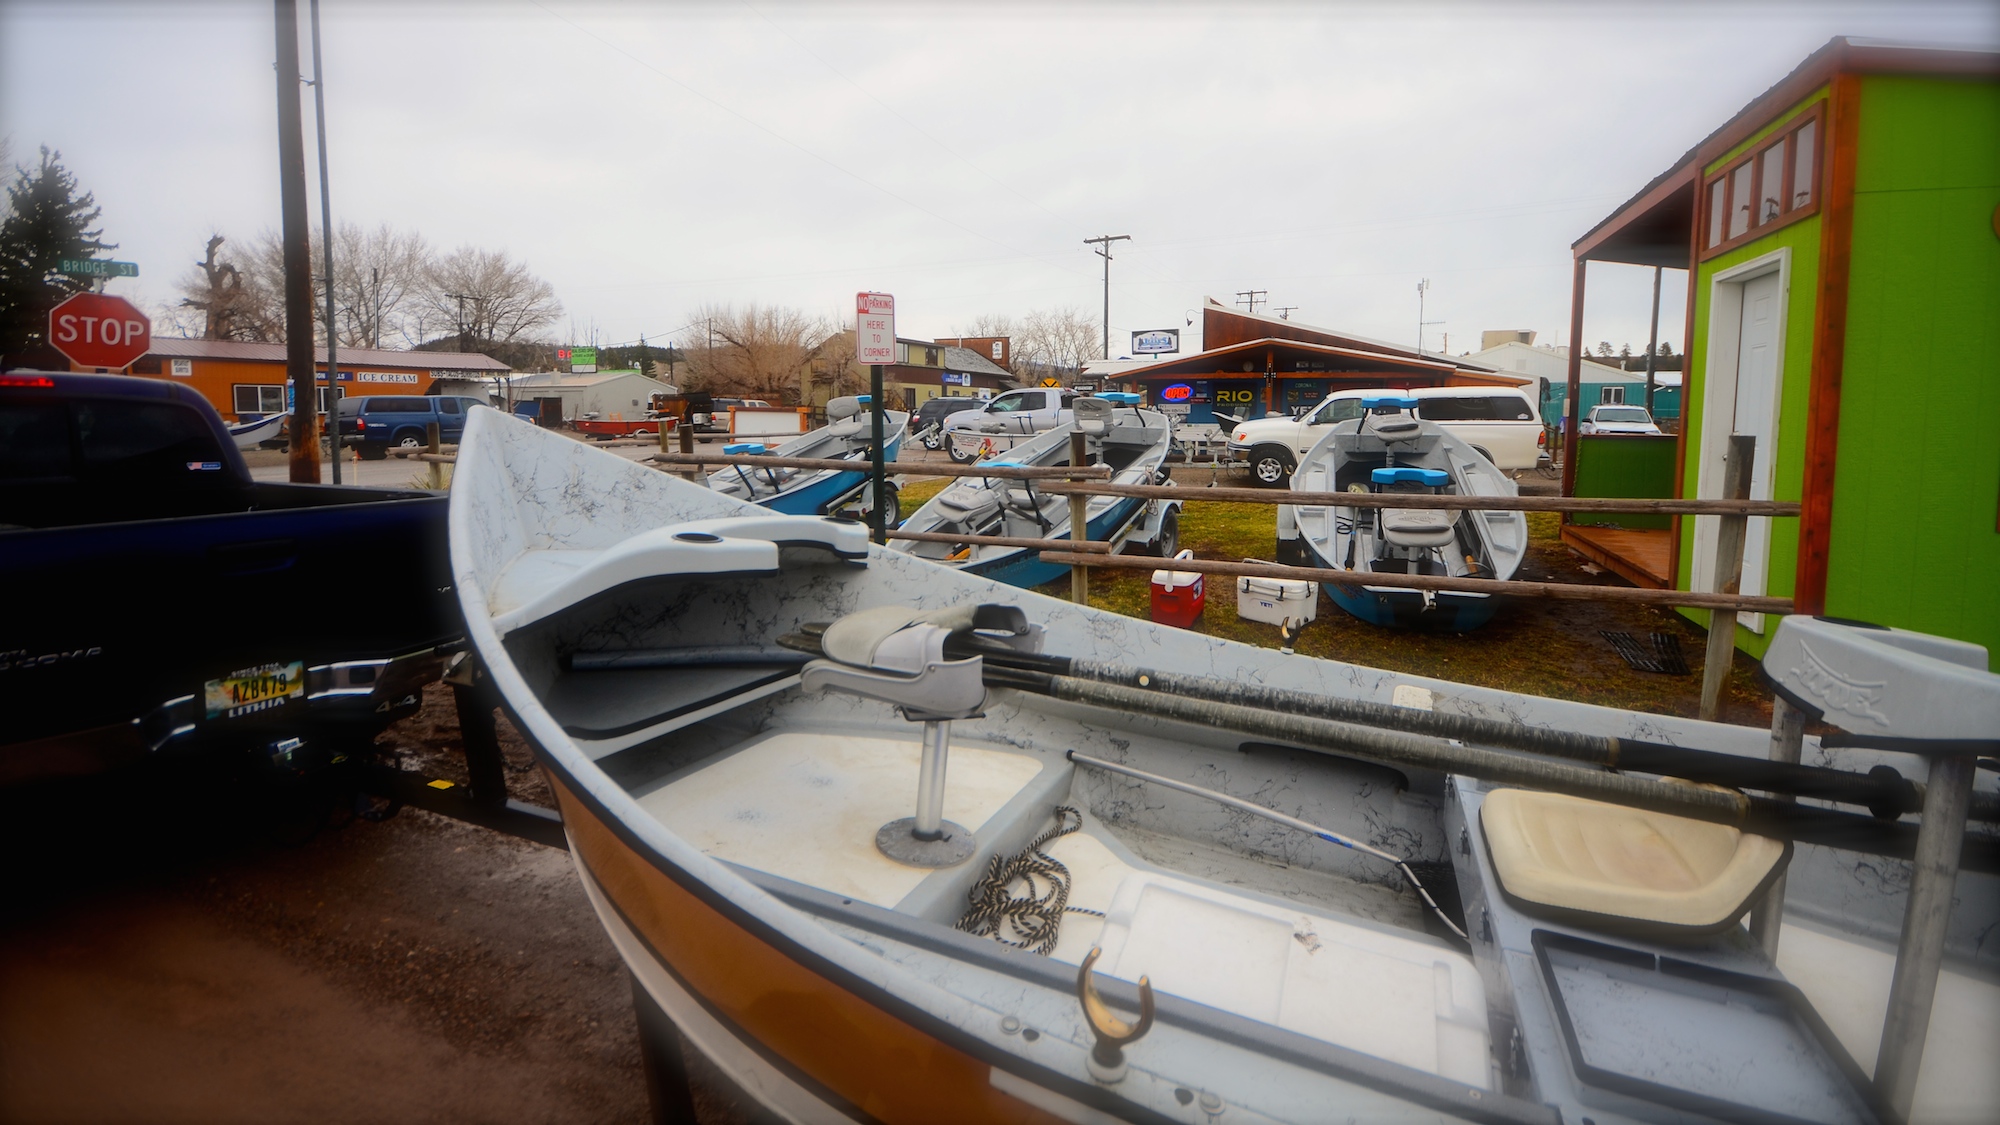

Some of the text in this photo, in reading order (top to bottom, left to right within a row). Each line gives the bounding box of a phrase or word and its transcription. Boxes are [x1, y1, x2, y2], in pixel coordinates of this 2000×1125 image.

[63, 260, 133, 275] BRIDGE ST
[858, 296, 892, 310] NO PARKING
[58, 314, 144, 346] STOP
[866, 320, 885, 330] HERE
[872, 333, 882, 343] TO
[863, 347, 891, 357] CORNER
[359, 373, 416, 383] ICE CREAM
[1165, 386, 1190, 399] OPEN
[1217, 390, 1253, 402] RIO
[232, 673, 287, 704] AZB479
[229, 697, 285, 718] LITHIA
[375, 694, 417, 713] 4x4
